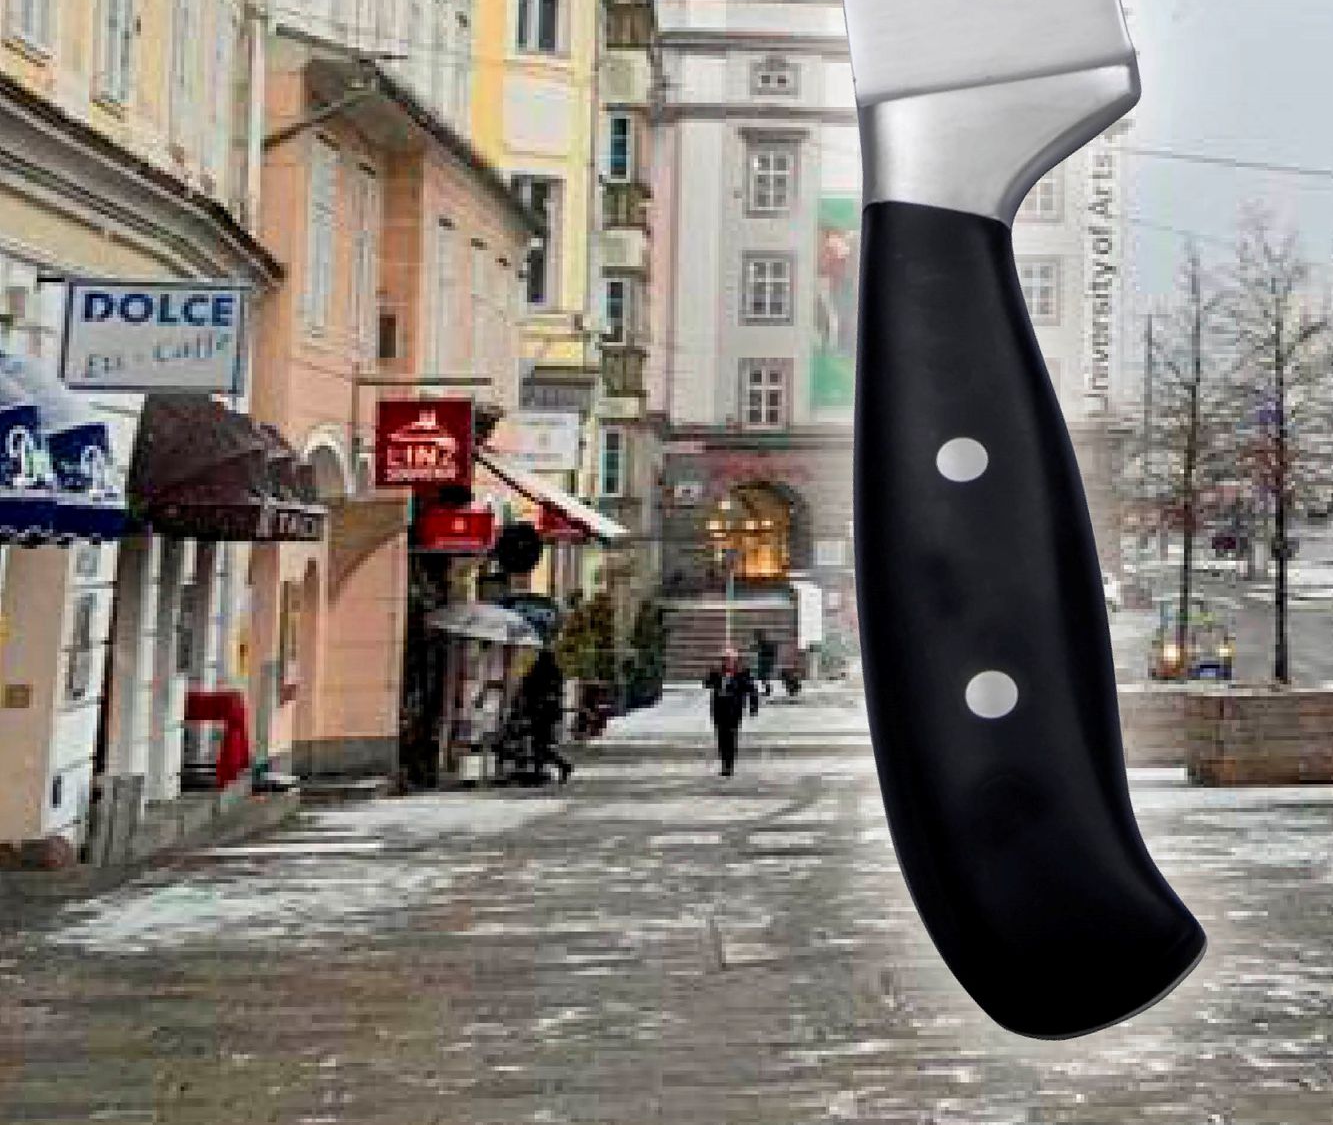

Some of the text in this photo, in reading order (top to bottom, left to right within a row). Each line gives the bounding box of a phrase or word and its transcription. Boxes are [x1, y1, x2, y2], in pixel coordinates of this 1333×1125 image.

[83, 293, 234, 327] DOLCE
[1085, 151, 1117, 414] University of Arts
